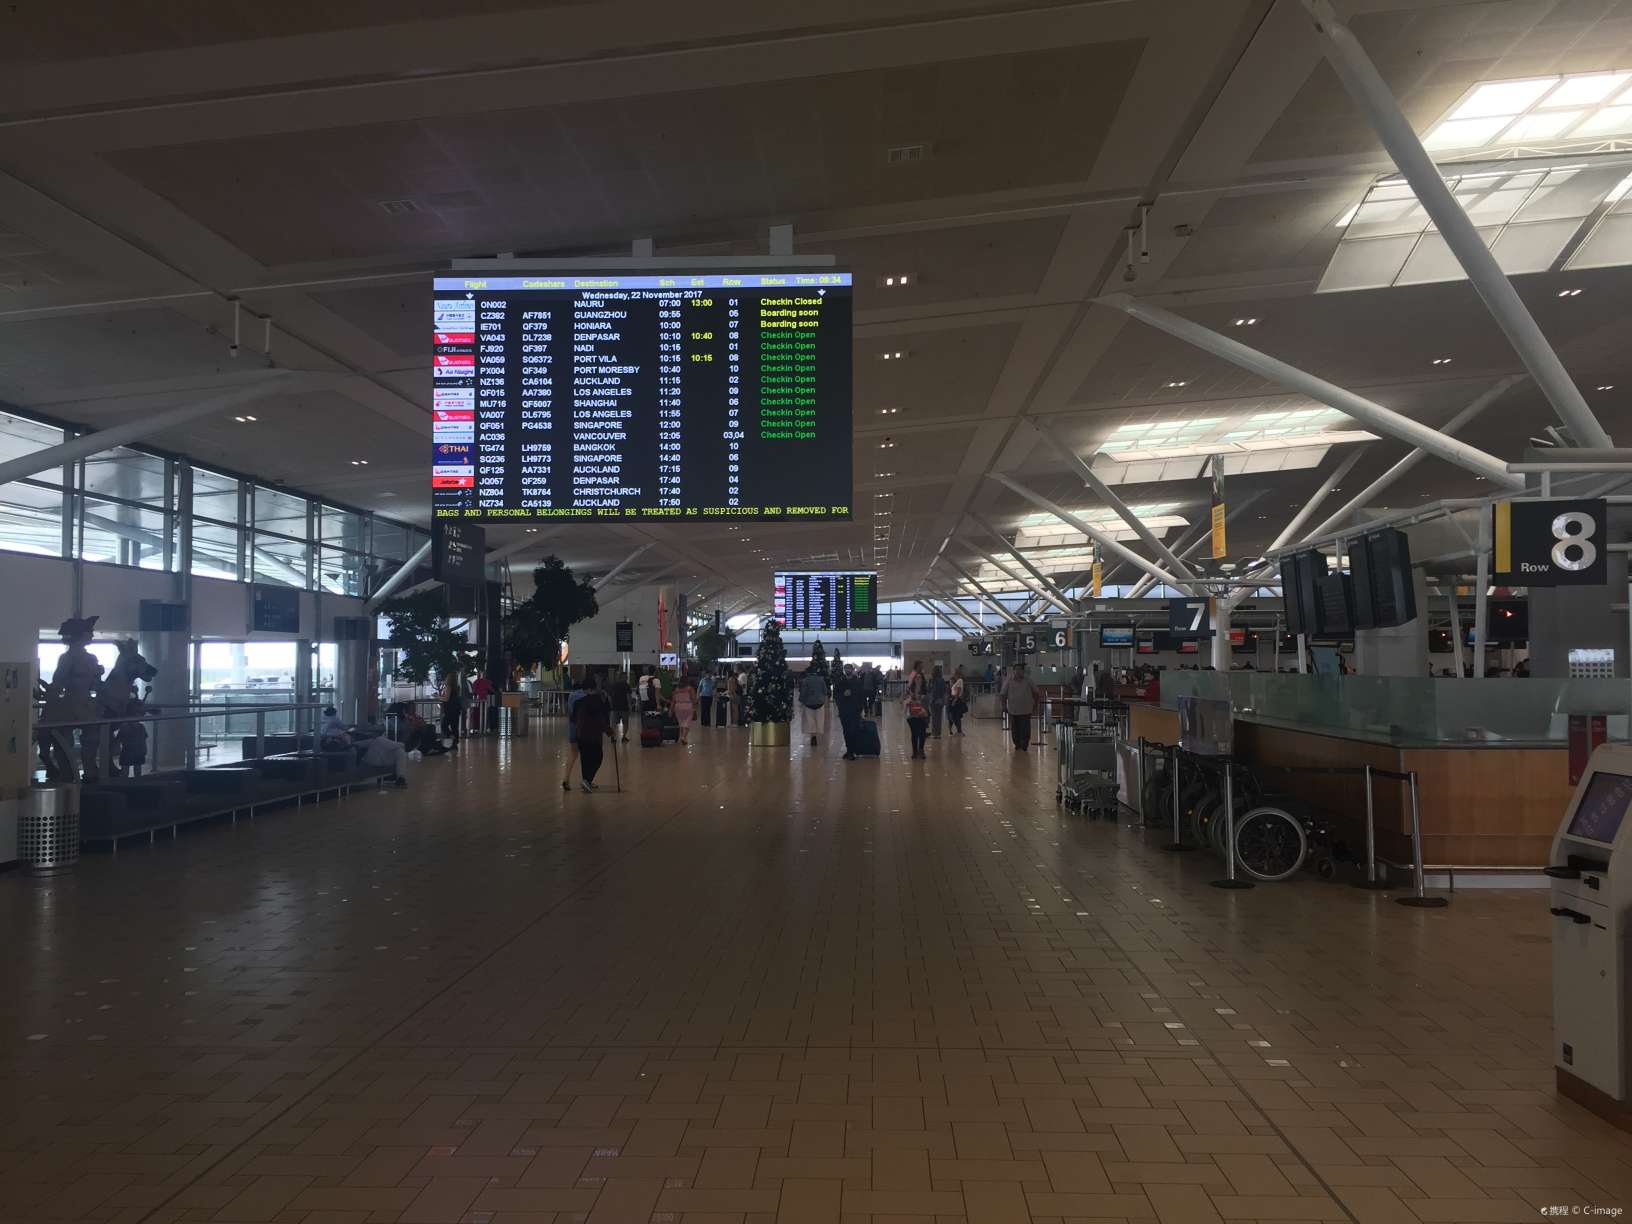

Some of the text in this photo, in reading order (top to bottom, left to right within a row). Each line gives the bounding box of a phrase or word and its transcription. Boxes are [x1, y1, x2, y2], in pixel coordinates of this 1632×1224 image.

[464, 280, 487, 289] Flight
[574, 279, 619, 288] Destination
[722, 278, 743, 286] Row
[760, 277, 786, 285] Status
[582, 290, 703, 300] Wednesday, 22 November 2017
[573, 300, 605, 308] NAURU
[658, 299, 682, 308] 07:00
[691, 298, 713, 307] 13:00
[728, 298, 739, 307] 01
[760, 297, 793, 306] Checkin
[794, 297, 823, 306] Closed
[574, 310, 627, 320] GUANGZHOU
[760, 308, 798, 318] Boarding
[798, 309, 819, 317] soon
[480, 322, 502, 331] IE701
[522, 322, 548, 331] QF379
[573, 322, 612, 330] HONIARA
[659, 321, 682, 330] 10:00
[728, 320, 739, 329] 07
[760, 319, 797, 329] Boarding
[798, 320, 819, 328] soon
[479, 333, 506, 342] VA043
[573, 332, 621, 341] DENPASAR
[659, 332, 682, 341] 10:10
[691, 332, 713, 340] 10:40
[760, 331, 793, 339] Checkin
[794, 330, 816, 340] Open
[480, 344, 504, 353] FJ920
[522, 344, 548, 353] QF397
[573, 344, 595, 352] NADI
[659, 343, 682, 352] 10:15
[728, 342, 739, 351] 01
[760, 341, 794, 351] Checkin
[794, 342, 816, 351] Open
[522, 355, 553, 364] SQ6372
[573, 355, 598, 364] PORT
[597, 355, 618, 363] VILA
[659, 354, 681, 363] 10:15
[691, 354, 713, 362] 10:15
[760, 352, 793, 361] Checkin
[794, 352, 816, 362] Open
[522, 366, 548, 375] QF349
[573, 366, 598, 374] PORT
[598, 365, 640, 374] MORESBY
[659, 365, 681, 374] 10:40
[729, 364, 740, 373] 10
[760, 364, 793, 372] Checkin
[794, 364, 816, 373] Open
[479, 375, 816, 386] NZ136 CA5104 AUCKLAND 11:15 02 Checkin Open
[479, 388, 506, 397] QF015
[573, 388, 592, 397] LOS
[591, 387, 633, 396] ANGELES
[659, 387, 681, 396] 11:20
[760, 386, 794, 395] Checkin
[794, 386, 816, 396] Open
[479, 399, 507, 408] MU716
[573, 399, 618, 408] SHANGHAI
[658, 398, 681, 407] 11:40
[760, 397, 794, 406] Checkin
[794, 397, 816, 406] Open
[479, 410, 505, 419] VA007
[573, 410, 592, 419] LOS
[591, 410, 633, 419] ANGELES
[659, 409, 681, 418] 11:55
[728, 408, 739, 417] 07
[760, 408, 793, 417] Checkin
[794, 408, 816, 418] Open
[479, 422, 505, 430] QF051
[573, 421, 623, 430] SINGAPORE
[659, 420, 681, 429] 12:00
[760, 419, 794, 428] Checkin
[794, 419, 816, 429] Open
[479, 430, 816, 441] AC036 VANCOUVER 12:05 03,04 Checkin Open
[450, 445, 470, 453] THAI
[479, 444, 505, 452] TG474
[573, 443, 616, 452] BANGKOK
[659, 442, 681, 451] 14:00
[729, 442, 739, 450] 10
[573, 454, 623, 463] SINGAPORE
[659, 453, 681, 462] 14:40
[521, 465, 551, 474] AA7331
[572, 465, 621, 474] AUCKLAND
[659, 464, 681, 473] 17:15
[521, 477, 547, 486] QF259
[573, 476, 620, 485] DENPASAR
[658, 476, 681, 484] 17:40
[728, 475, 739, 484] 04
[573, 487, 641, 496] CHRISTCHURCH
[659, 487, 681, 495] 17:40
[728, 486, 739, 495] 02
[478, 499, 504, 508] NZ734
[520, 499, 552, 508] CA5139
[572, 498, 621, 507] AUCKLAND
[728, 497, 739, 506] 02
[436, 506, 849, 517] BAGS AND PERSONAL BELONGINGS WILL BE TREATED AS SUSPICIOUS AND REMOVED FOR
[1520, 511, 1597, 572] Row 8
[1186, 602, 1206, 631] 7
[1026, 635, 1036, 649] 5
[1055, 631, 1066, 647] 6
[985, 643, 992, 654] 4
